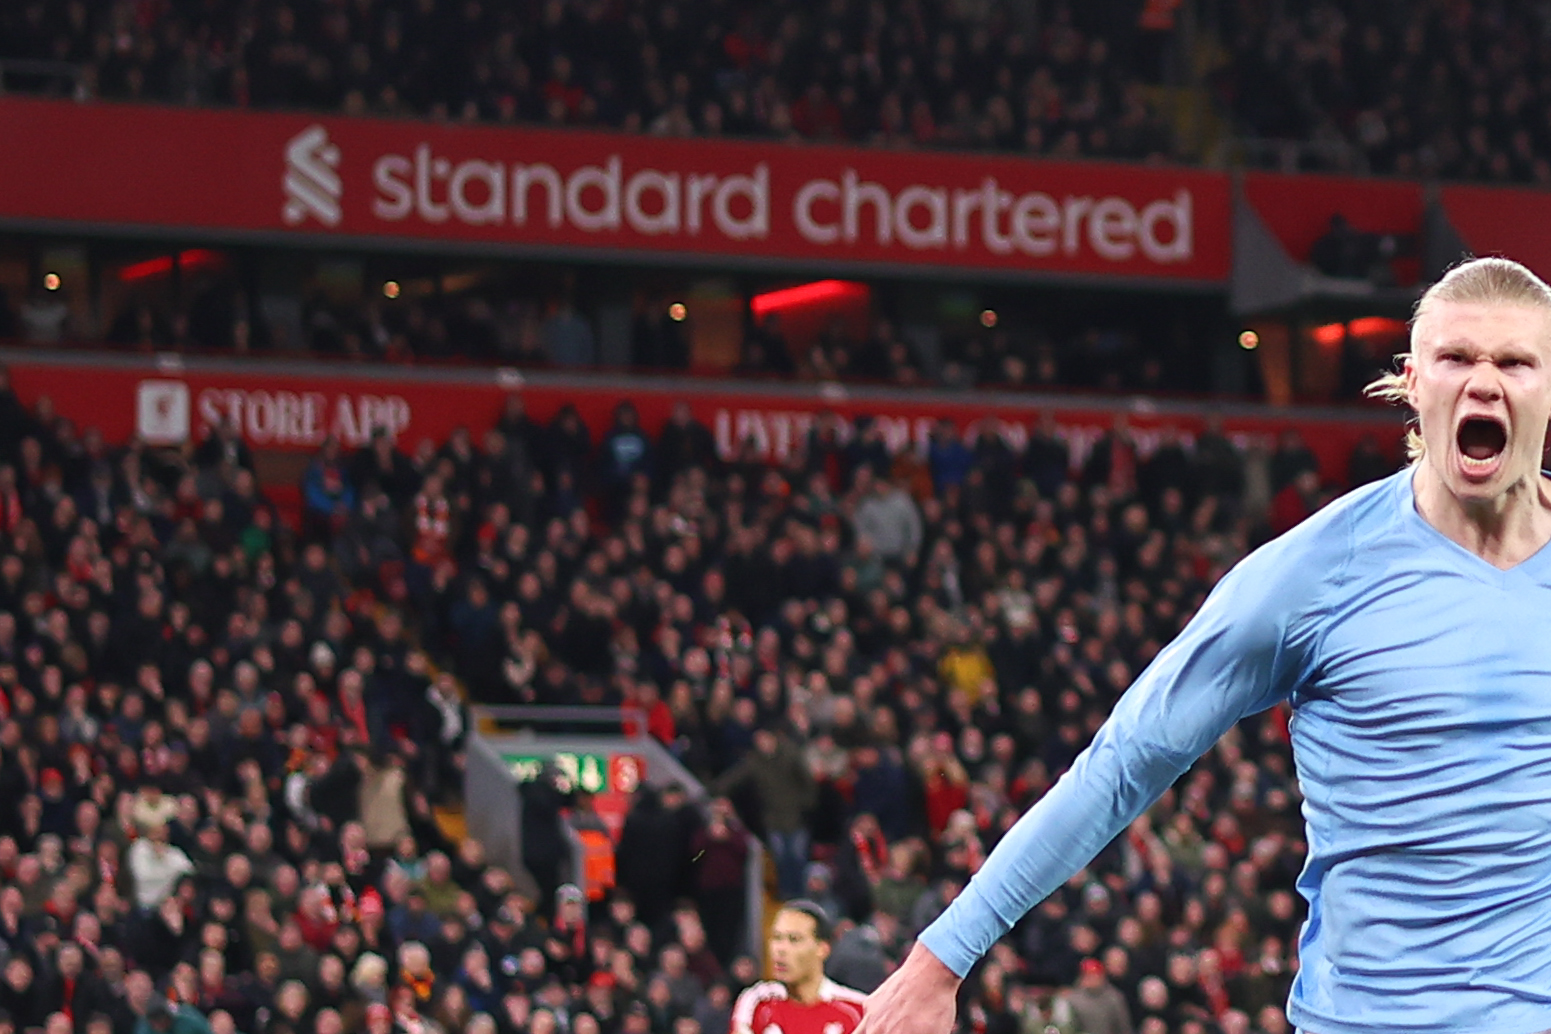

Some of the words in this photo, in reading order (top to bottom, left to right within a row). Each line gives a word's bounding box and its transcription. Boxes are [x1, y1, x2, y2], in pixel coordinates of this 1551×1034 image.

[372, 142, 769, 239] standard
[792, 168, 1194, 262] chartered
[198, 388, 328, 445] STORE
[332, 394, 411, 449] APP
